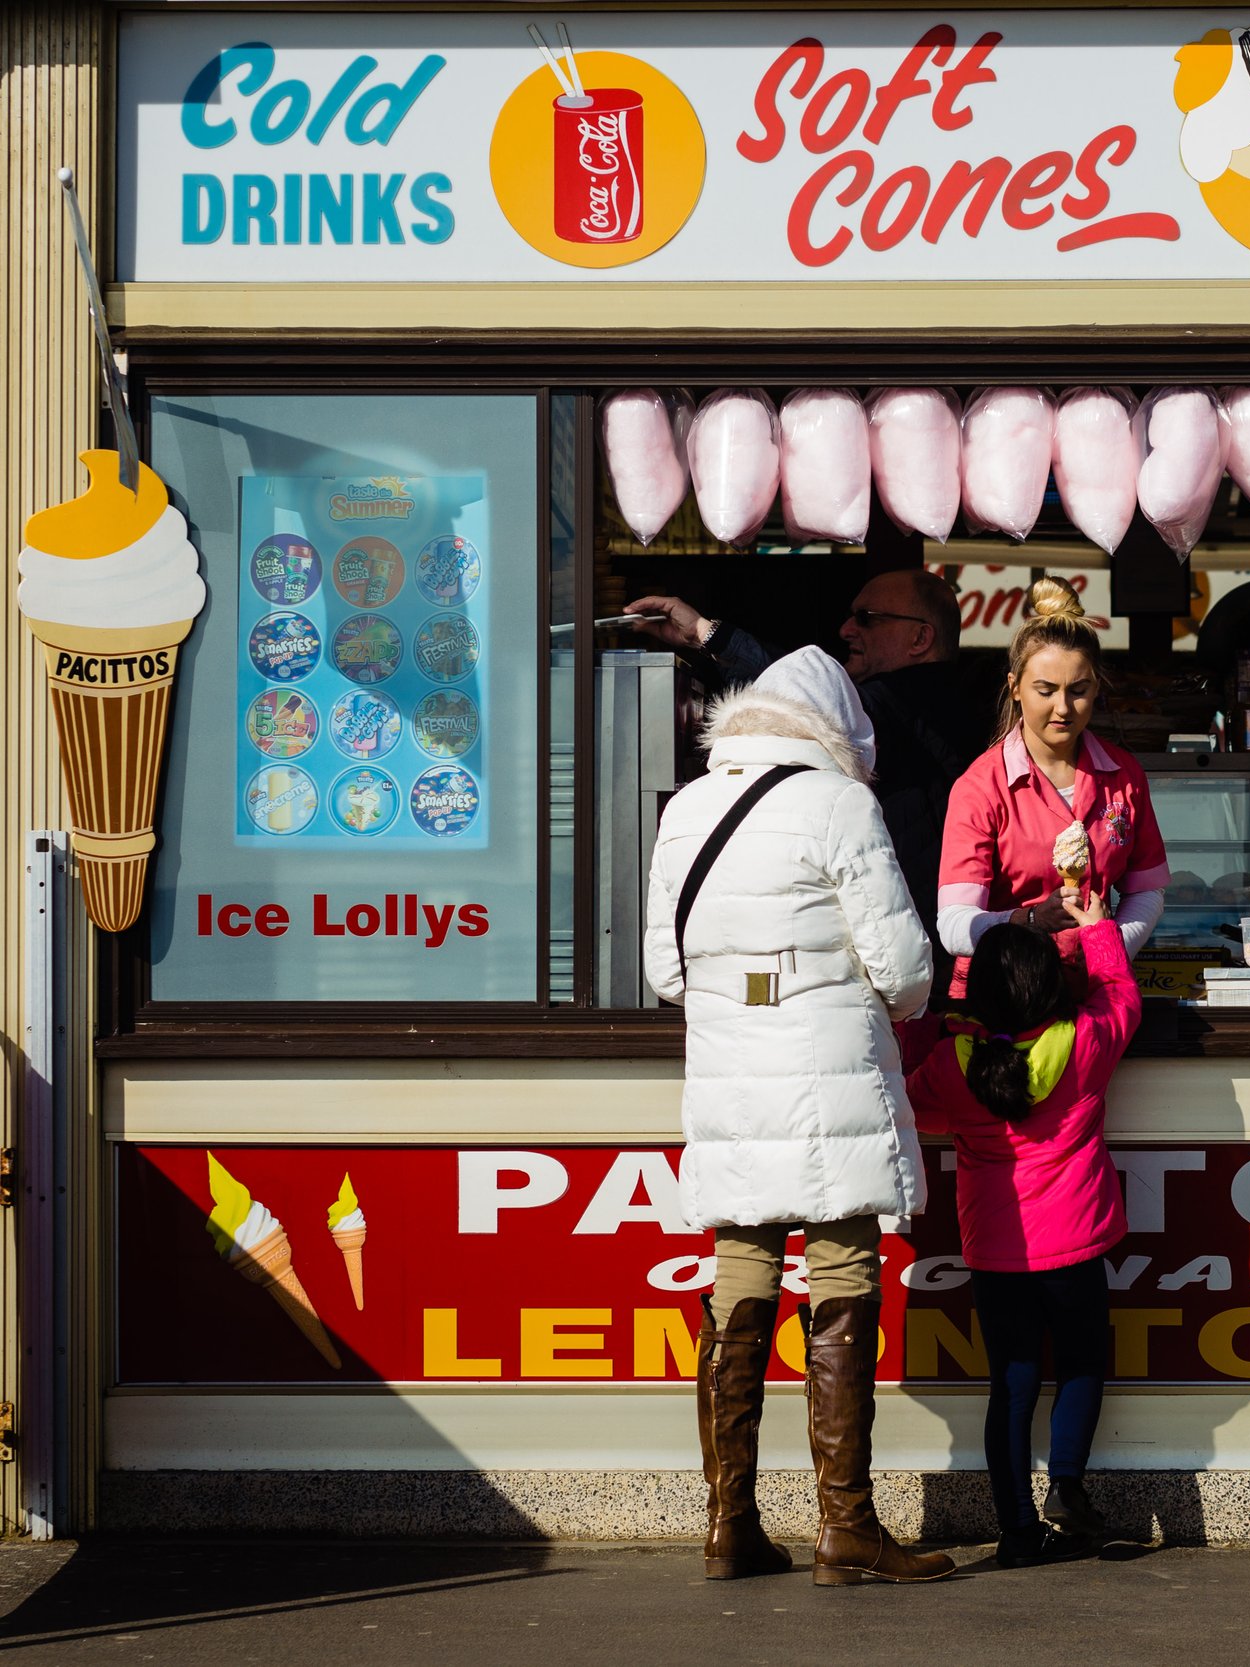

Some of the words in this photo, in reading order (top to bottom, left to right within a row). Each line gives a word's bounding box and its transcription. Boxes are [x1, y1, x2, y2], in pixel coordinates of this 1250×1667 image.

[180, 41, 447, 149] Cold
[736, 23, 1004, 163] Soft
[577, 113, 620, 239] Coca-Cola
[787, 124, 1137, 267] Cones
[181, 172, 455, 245] DRINKS
[347, 484, 379, 498] taste
[330, 495, 414, 520] Summer
[256, 558, 280, 569] Fruit
[256, 564, 285, 579] Shoot
[339, 560, 364, 571] Fruit
[339, 567, 370, 582] Shoot
[257, 637, 312, 659] SMARTIES
[421, 632, 474, 667] FESTIVAL
[55, 651, 170, 684] PACITTOS
[420, 716, 472, 736] FESTIVAL
[417, 793, 471, 809] SMARTIES
[197, 894, 290, 937] Ice
[313, 894, 489, 948] Lollys
[1138, 968, 1177, 990] ake
